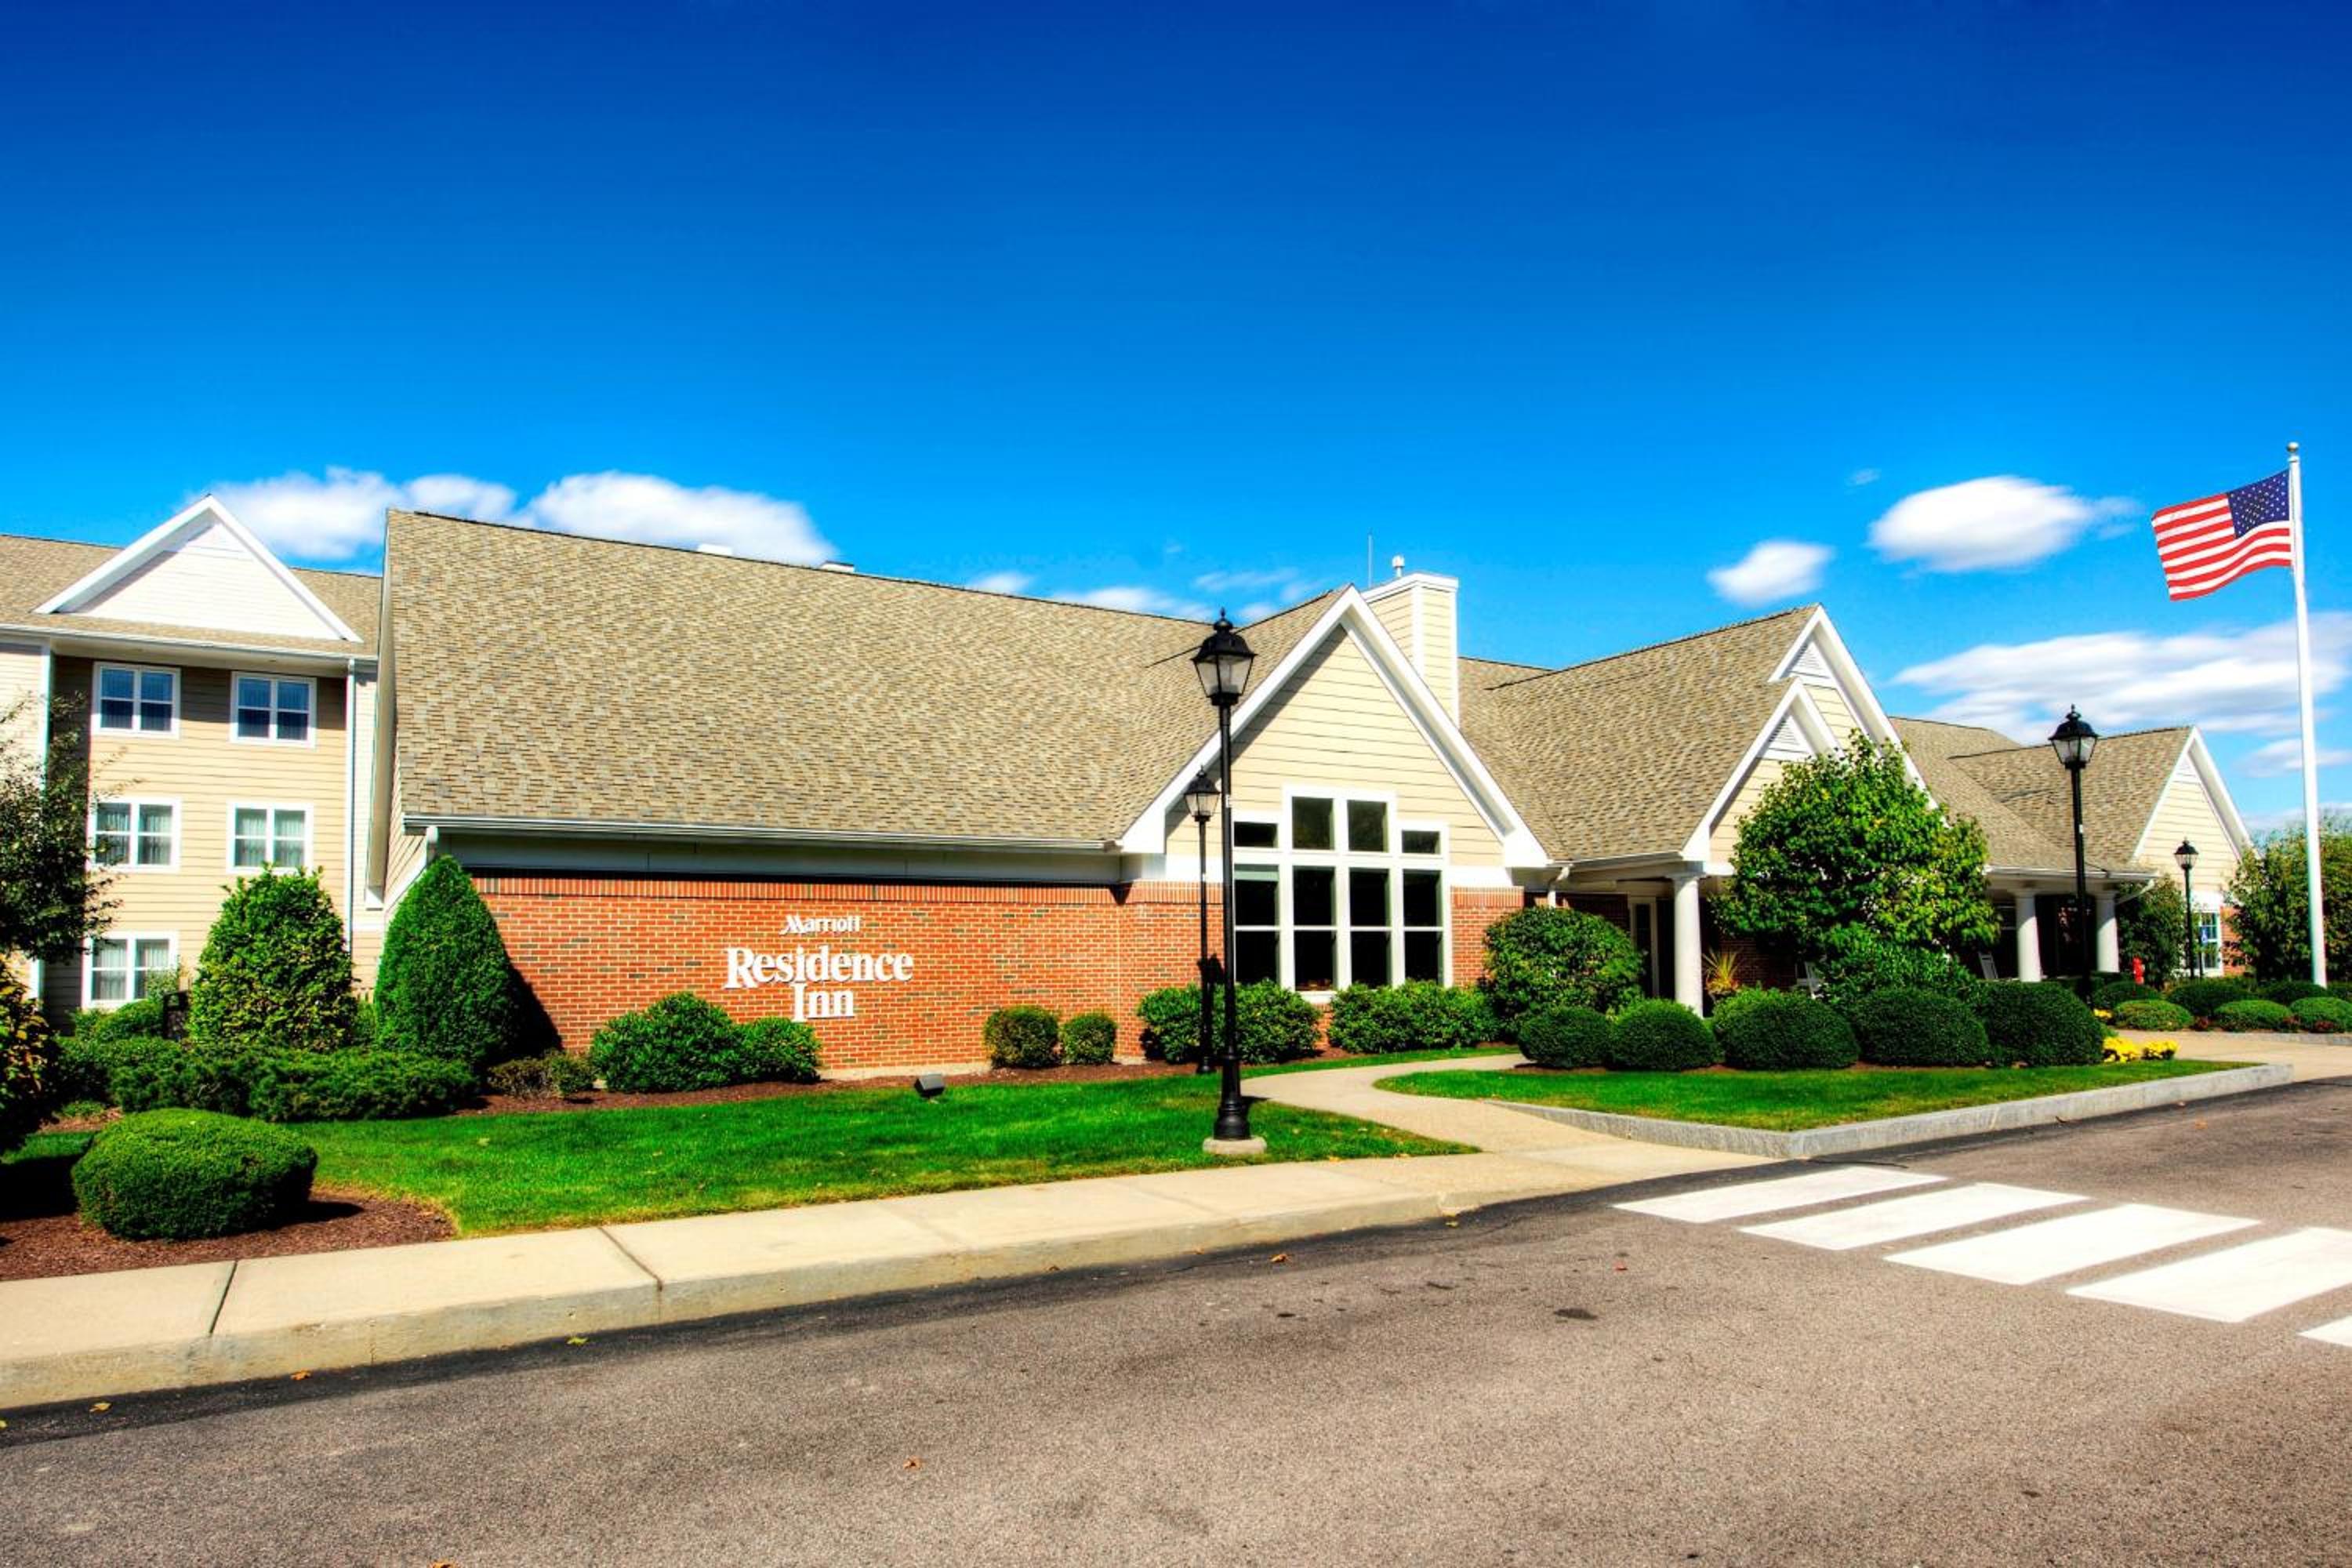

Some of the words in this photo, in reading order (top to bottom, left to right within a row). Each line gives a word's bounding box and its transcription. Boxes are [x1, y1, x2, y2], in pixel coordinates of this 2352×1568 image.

[779, 915, 861, 935] Marriott
[723, 946, 914, 989] Residence
[790, 982, 855, 1022] Inn
